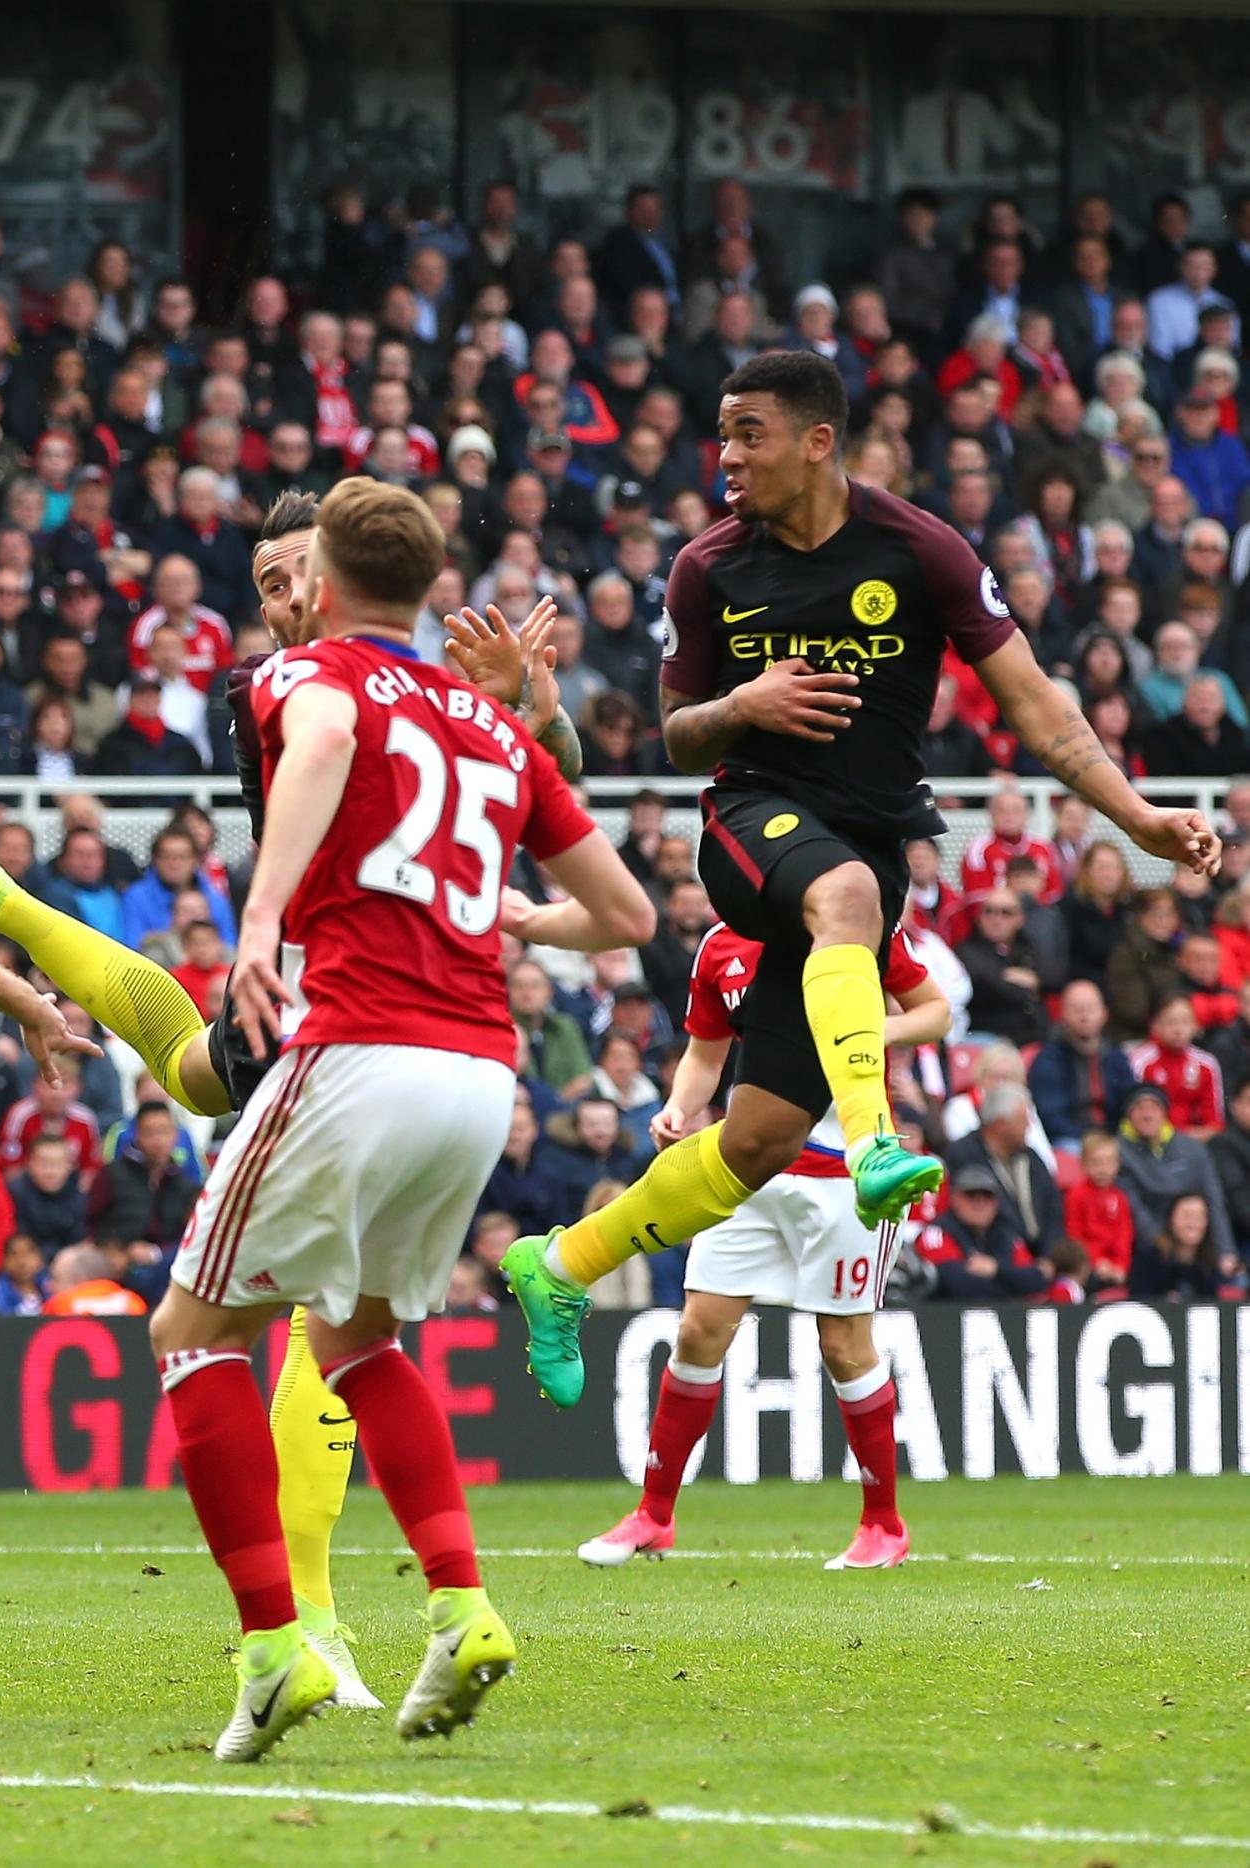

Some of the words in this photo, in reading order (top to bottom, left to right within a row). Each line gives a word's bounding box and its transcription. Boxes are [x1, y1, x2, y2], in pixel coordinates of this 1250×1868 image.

[729, 632, 905, 660] ETIHAD
[356, 716, 519, 936] 25
[831, 1257, 869, 1300] 19
